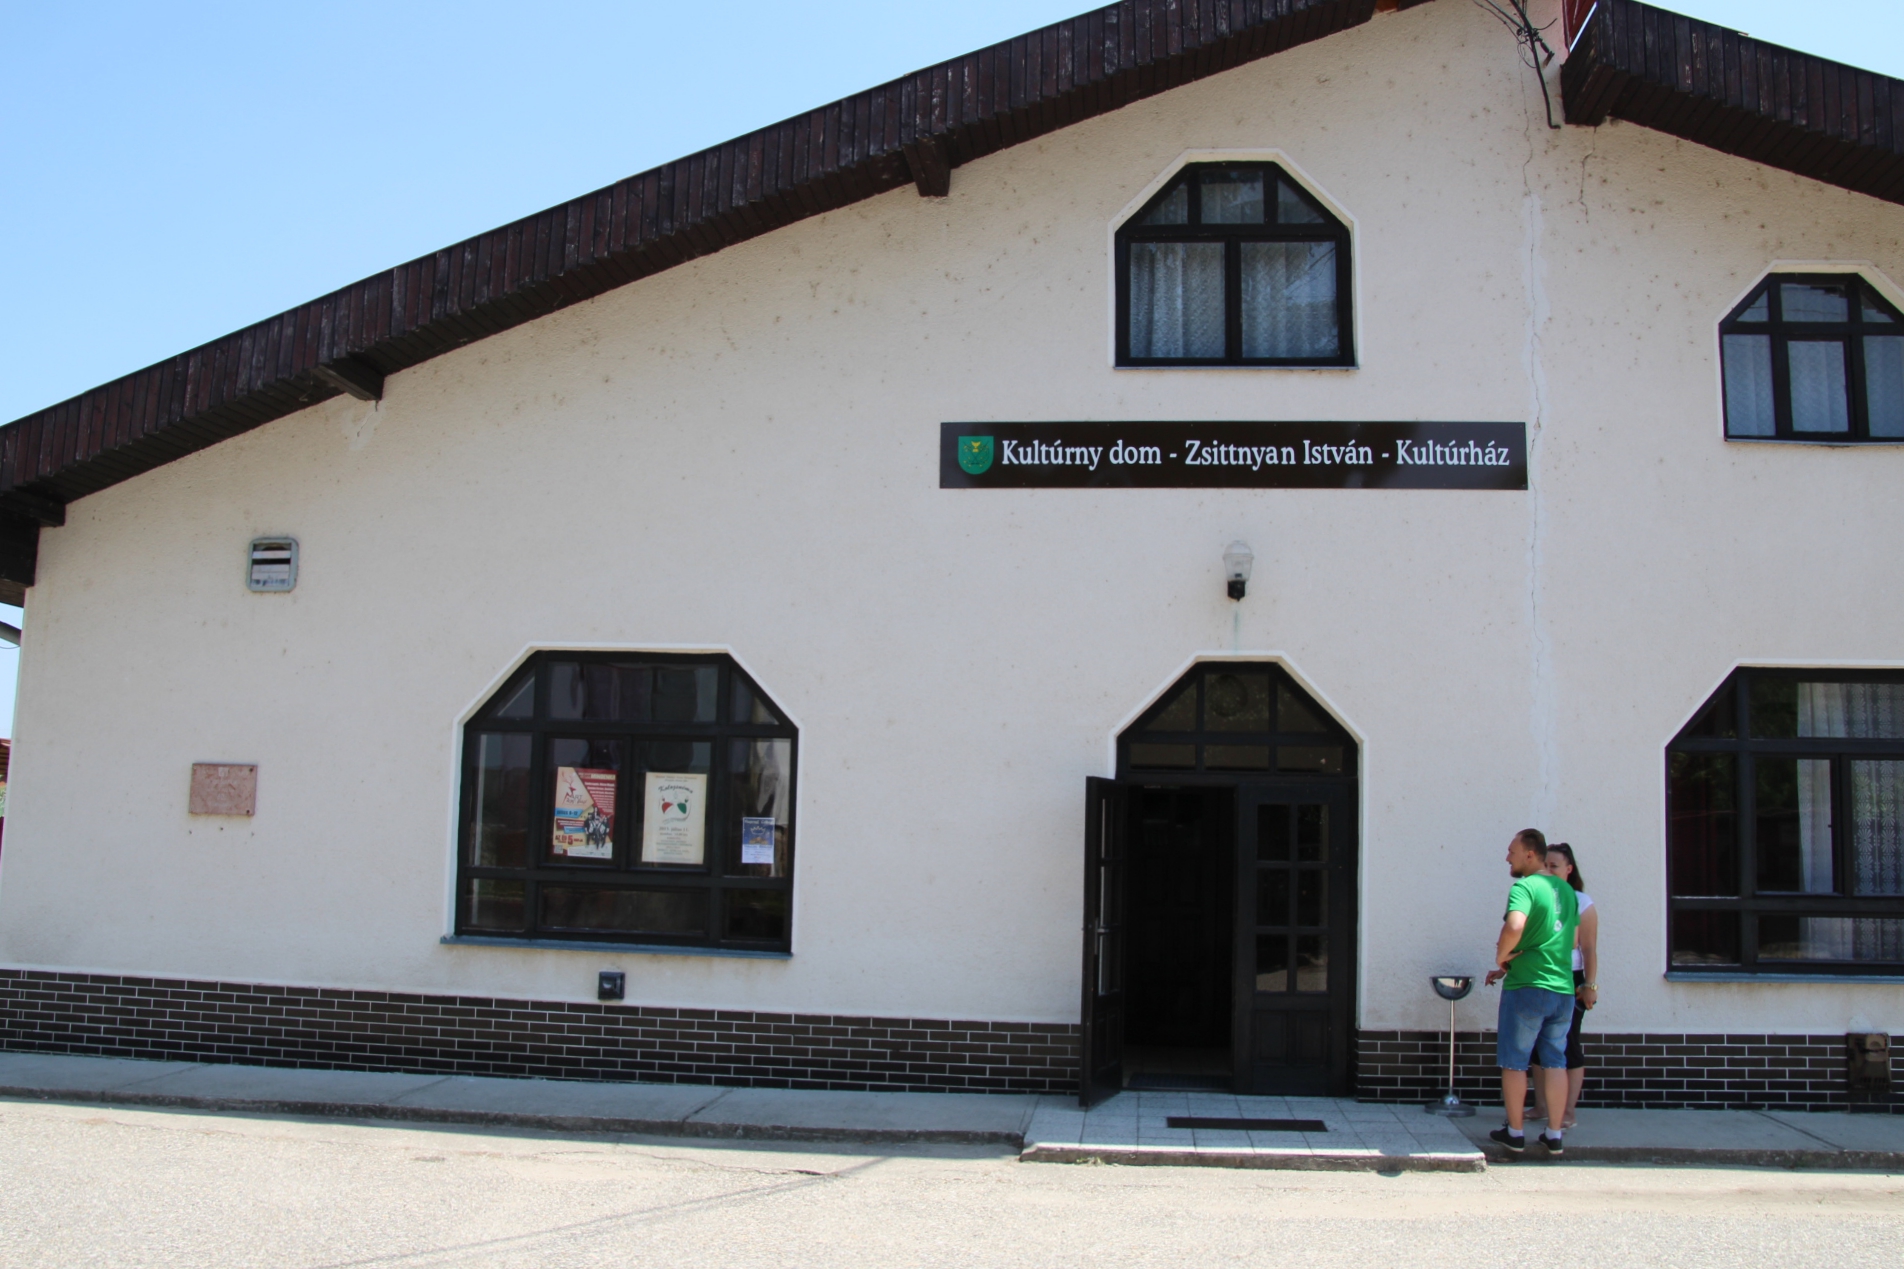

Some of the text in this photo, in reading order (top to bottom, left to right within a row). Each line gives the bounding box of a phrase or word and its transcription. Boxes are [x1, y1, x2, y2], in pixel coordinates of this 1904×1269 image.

[1001, 439, 1103, 471] Kultúrny
[1109, 439, 1162, 465] dom
[1185, 439, 1296, 471] Zsittnyan
[1303, 439, 1373, 465] István
[1396, 439, 1510, 466] Kultúrház
